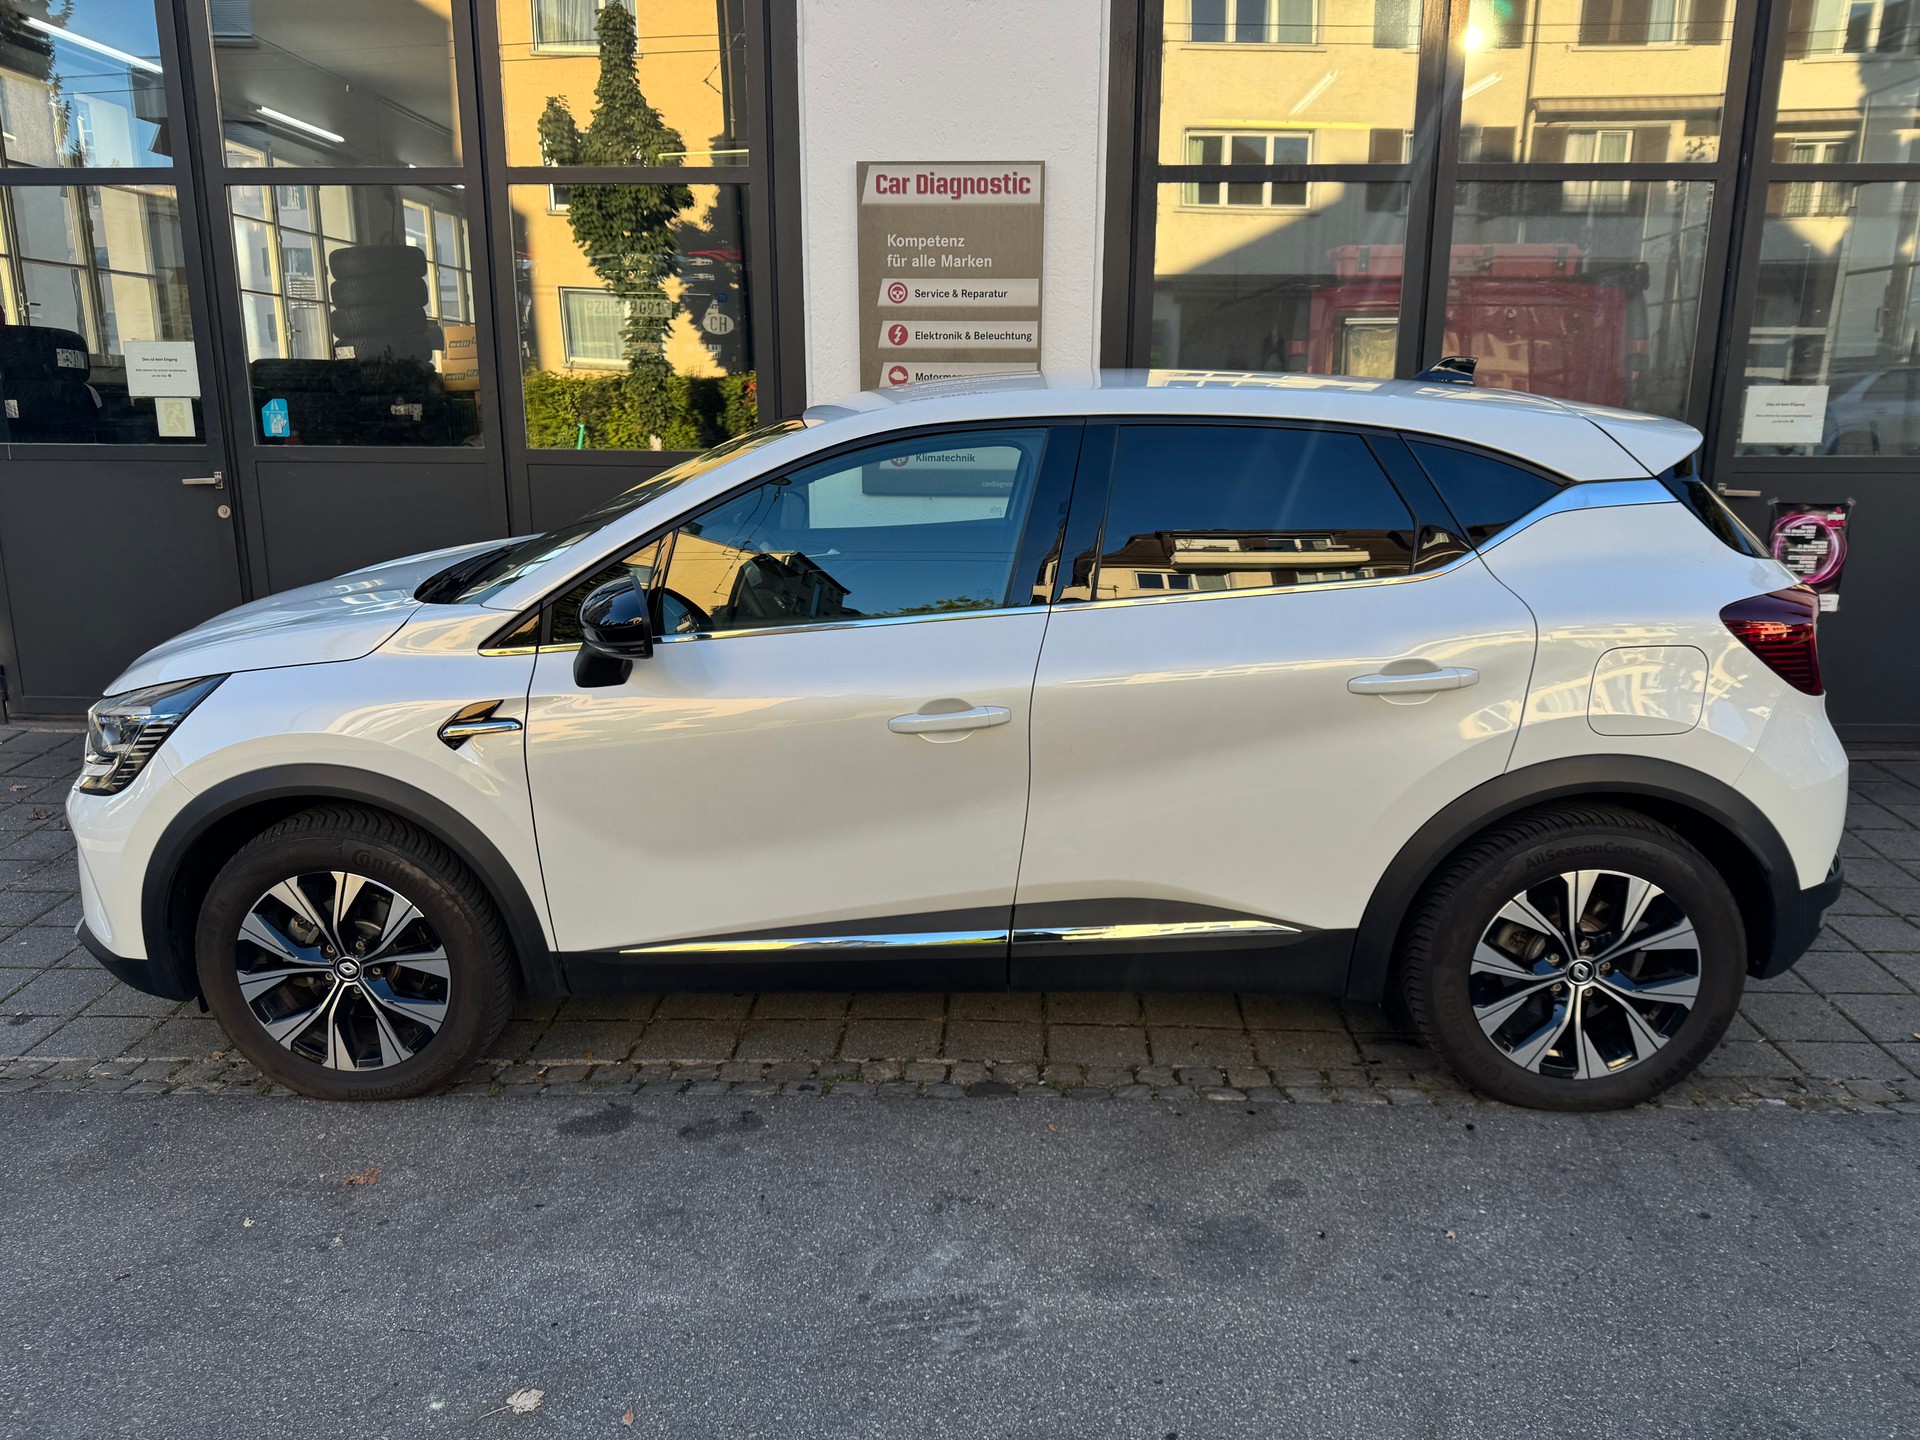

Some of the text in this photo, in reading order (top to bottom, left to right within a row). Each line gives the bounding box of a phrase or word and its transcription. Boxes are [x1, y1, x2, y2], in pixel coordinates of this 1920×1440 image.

[875, 171, 1031, 200] Car Diagnostic
[886, 233, 965, 250] Kompetenz
[886, 254, 993, 268] für alle Marken
[914, 288, 1008, 301] Service & Reparatur
[710, 316, 727, 333] CH
[914, 331, 1033, 343] Elektronik & Beleuchtung
[915, 453, 976, 463] Klimatechnik
